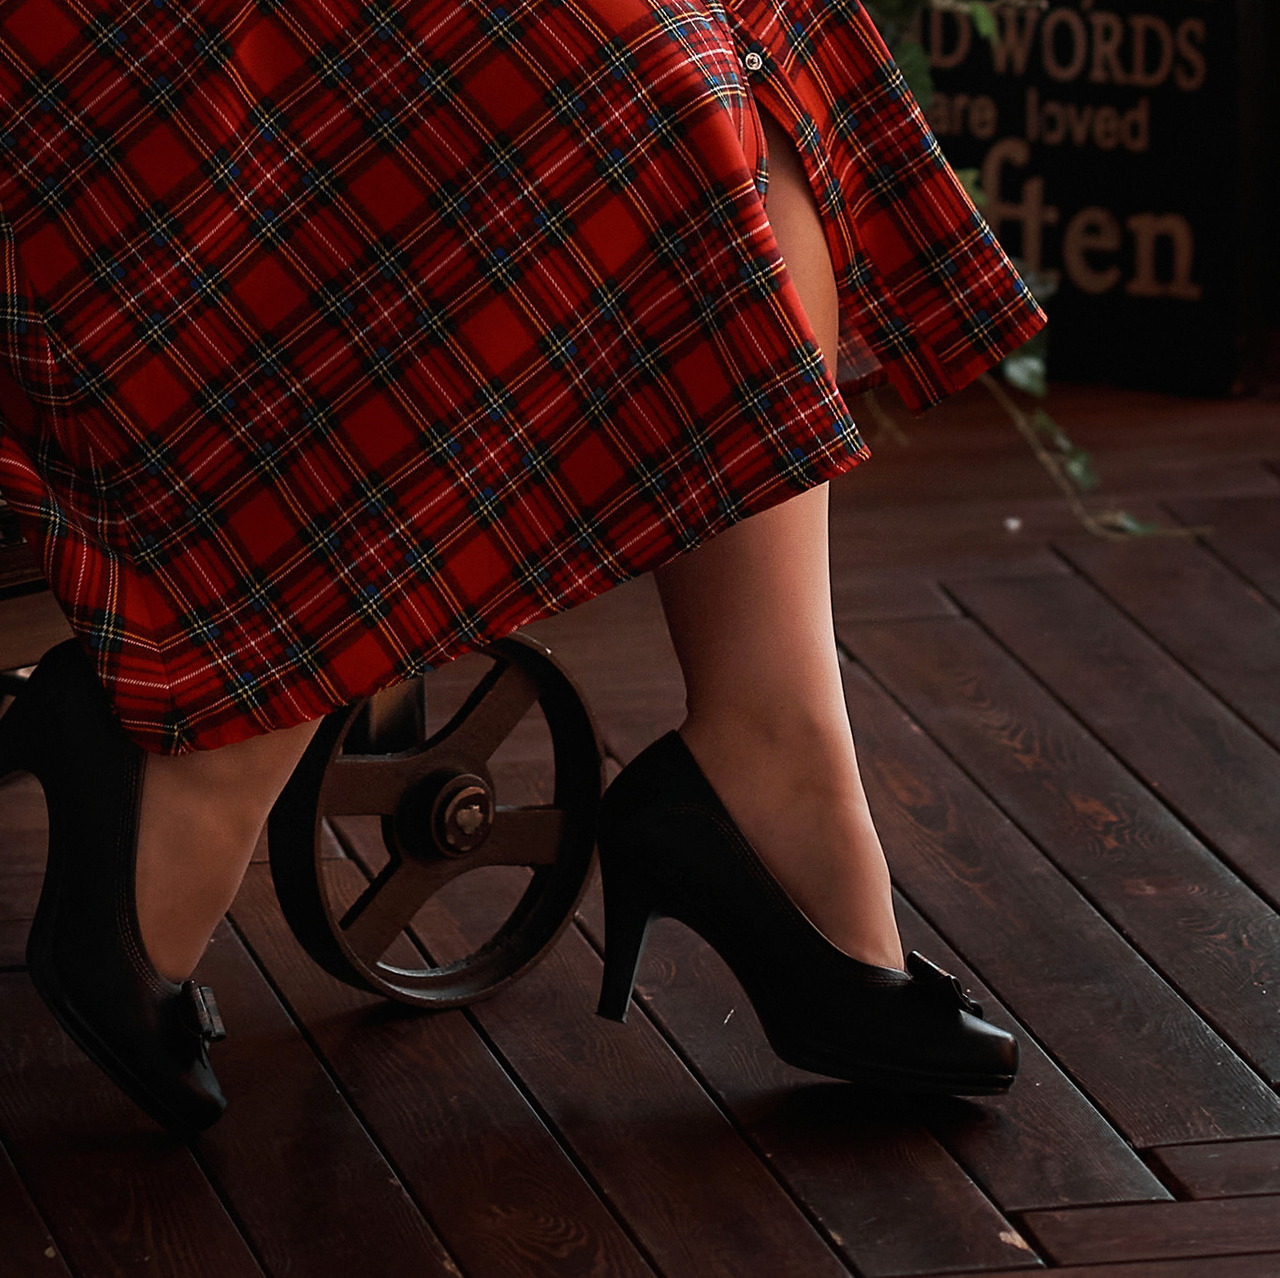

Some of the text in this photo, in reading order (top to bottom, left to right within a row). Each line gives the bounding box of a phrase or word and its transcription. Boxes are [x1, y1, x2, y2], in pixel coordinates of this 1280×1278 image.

[988, 6, 1208, 93] WORDS
[1025, 83, 1151, 153] loved
[980, 135, 1203, 302] ften
